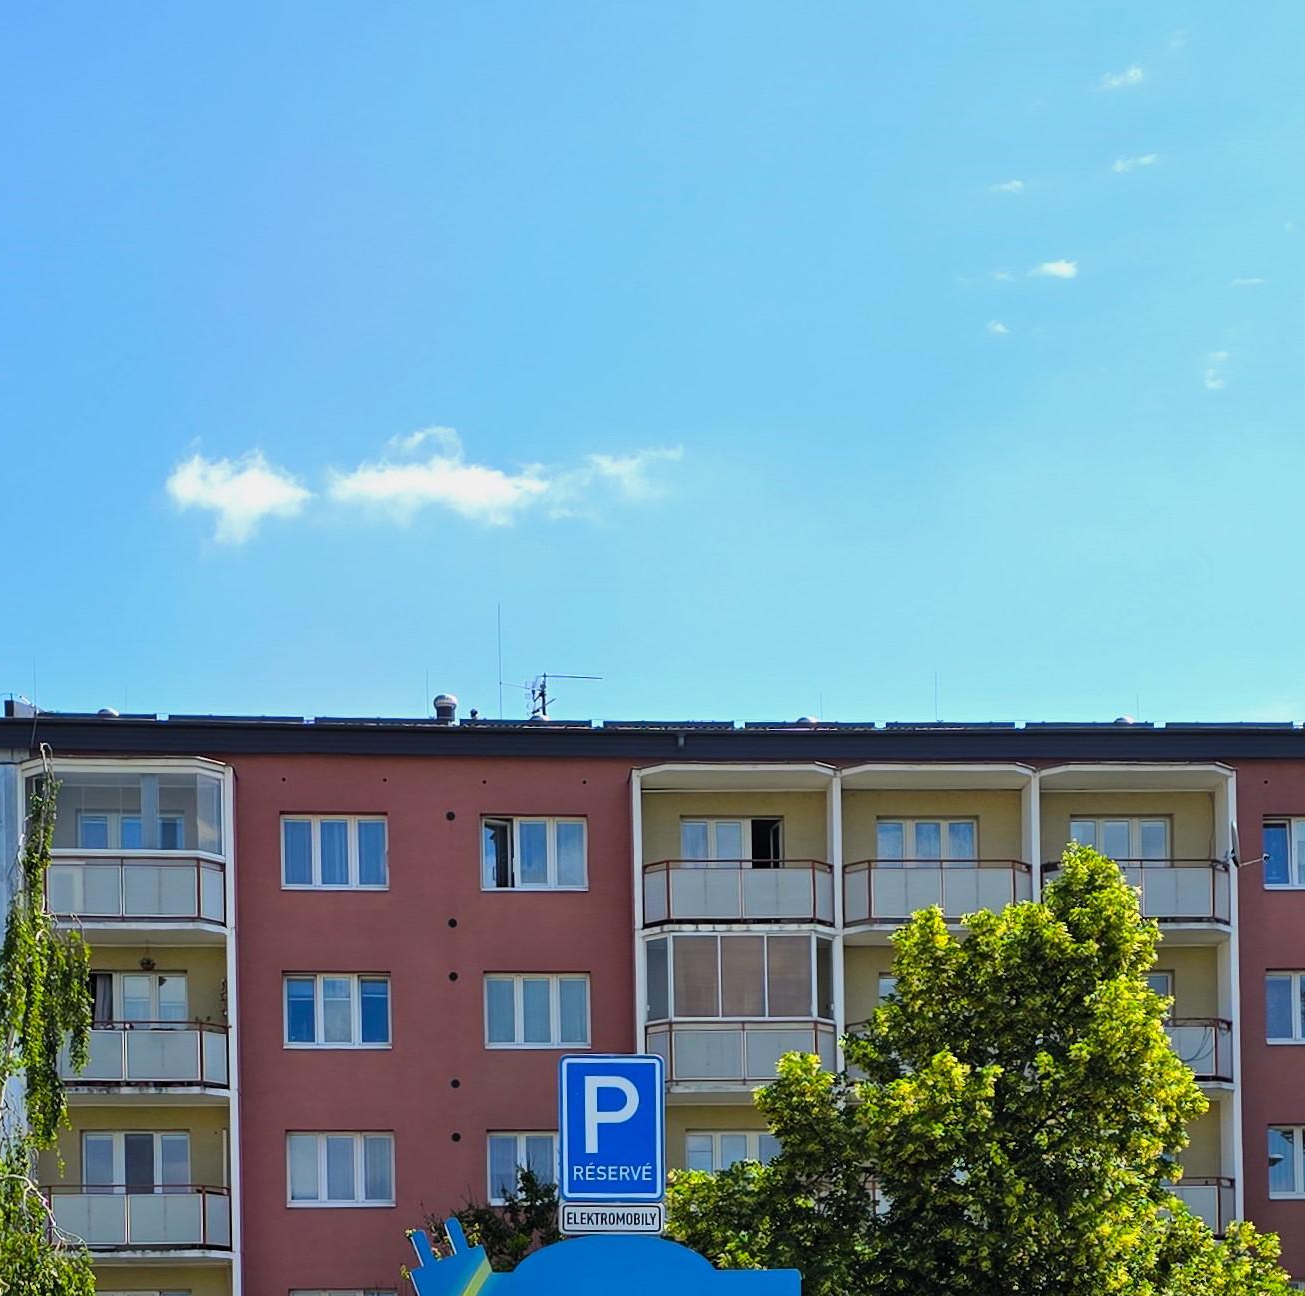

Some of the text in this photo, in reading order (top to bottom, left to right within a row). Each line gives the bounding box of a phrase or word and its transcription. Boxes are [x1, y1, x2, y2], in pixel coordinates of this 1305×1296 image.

[584, 1075, 640, 1154] P
[573, 1162, 652, 1181] RÉSERVÉ
[566, 1212, 657, 1226] ELEKTROMOBILY
